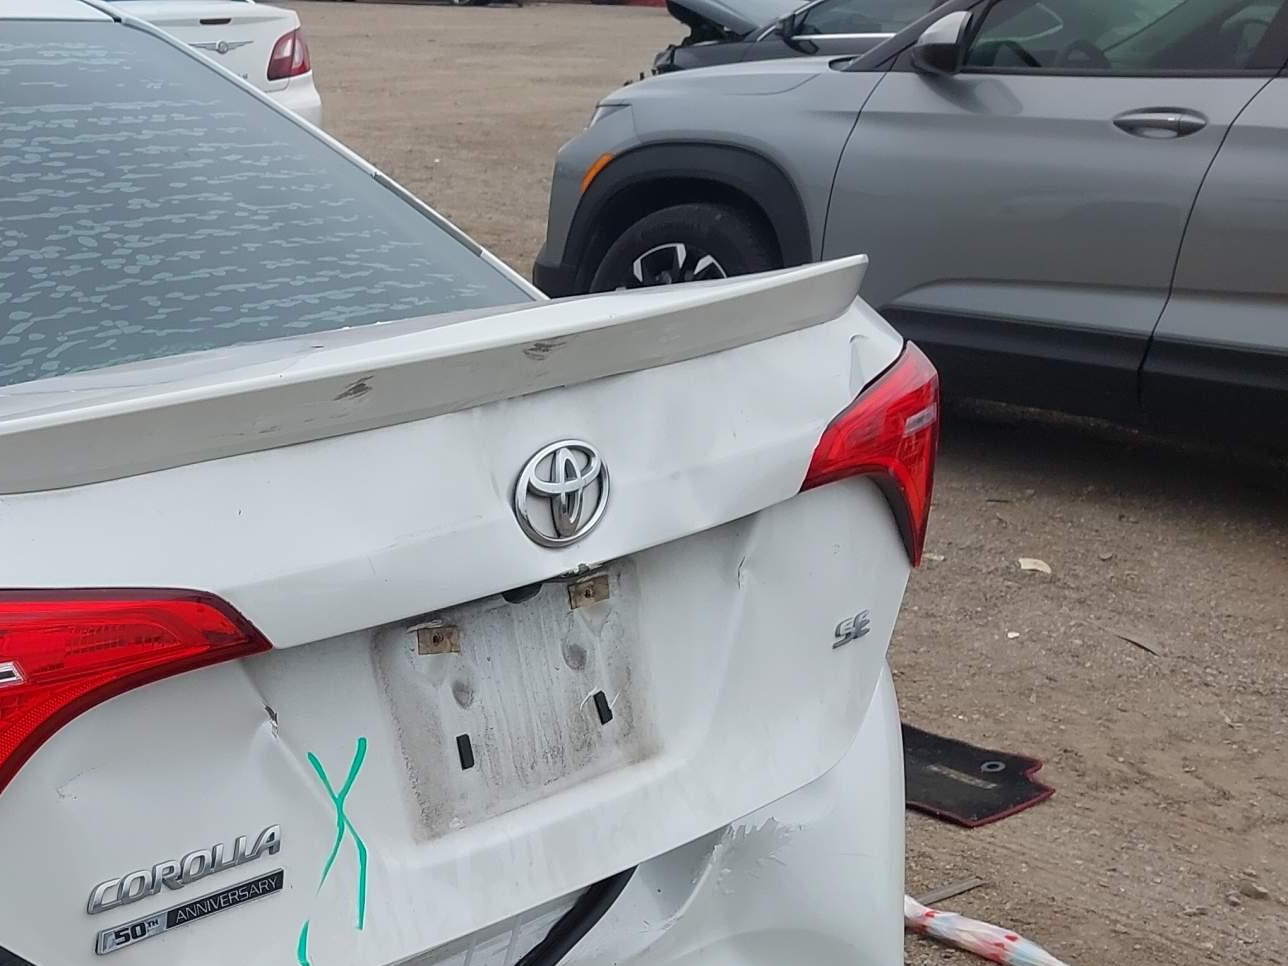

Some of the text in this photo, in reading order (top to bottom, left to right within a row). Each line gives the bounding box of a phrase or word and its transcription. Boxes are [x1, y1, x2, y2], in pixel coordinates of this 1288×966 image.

[832, 609, 870, 650] SE
[87, 824, 281, 914] COROLLA
[114, 876, 279, 946] 50TH ANNIVERSARY
